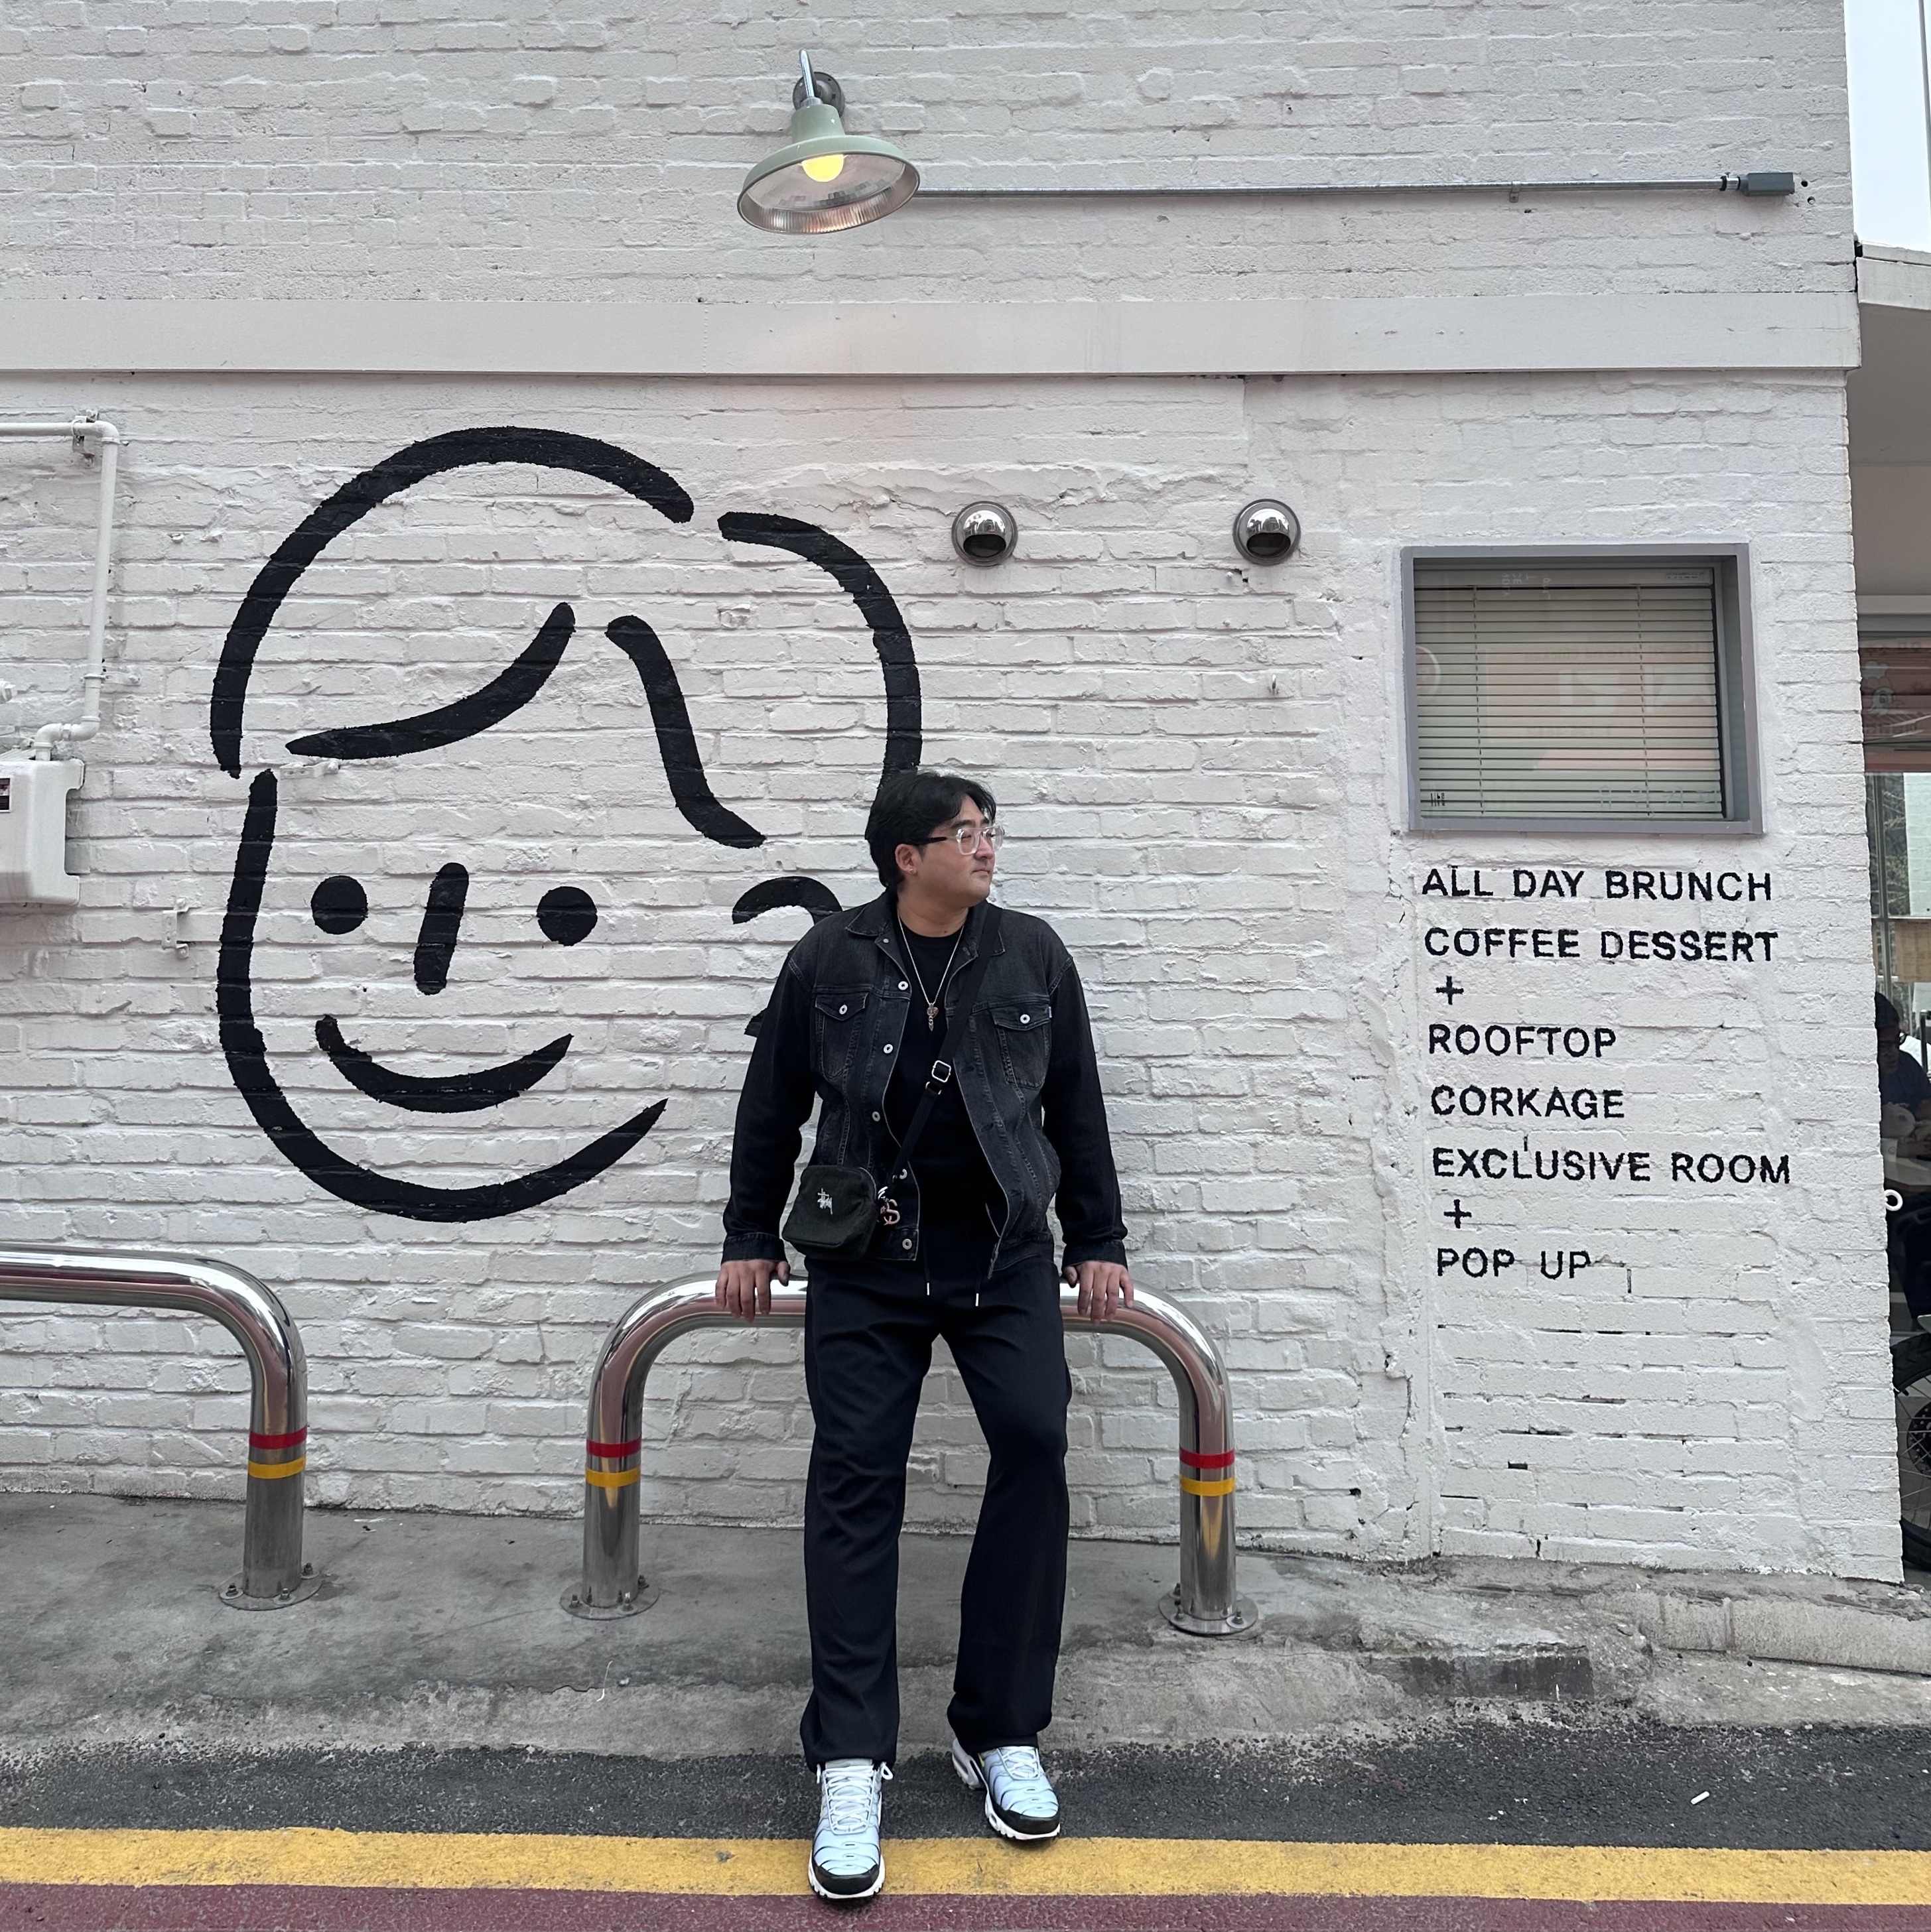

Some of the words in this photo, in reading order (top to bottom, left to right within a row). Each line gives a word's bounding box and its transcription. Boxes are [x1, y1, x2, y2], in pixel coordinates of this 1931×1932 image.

[1422, 868, 1494, 897] ALL
[1512, 869, 1585, 898] DAY
[1605, 869, 1771, 901] BRUNCH
[1424, 927, 1580, 958] COFFEE
[1601, 930, 1778, 961] DESSERT
[1429, 1023, 1617, 1058] ROOFTOP
[1431, 1084, 1625, 1120] CORKAGE
[1432, 1147, 1650, 1182] EXCLUSIVE
[1671, 1151, 1790, 1185] ROOM
[1437, 1247, 1515, 1278] POP
[1540, 1250, 1590, 1281] UP
